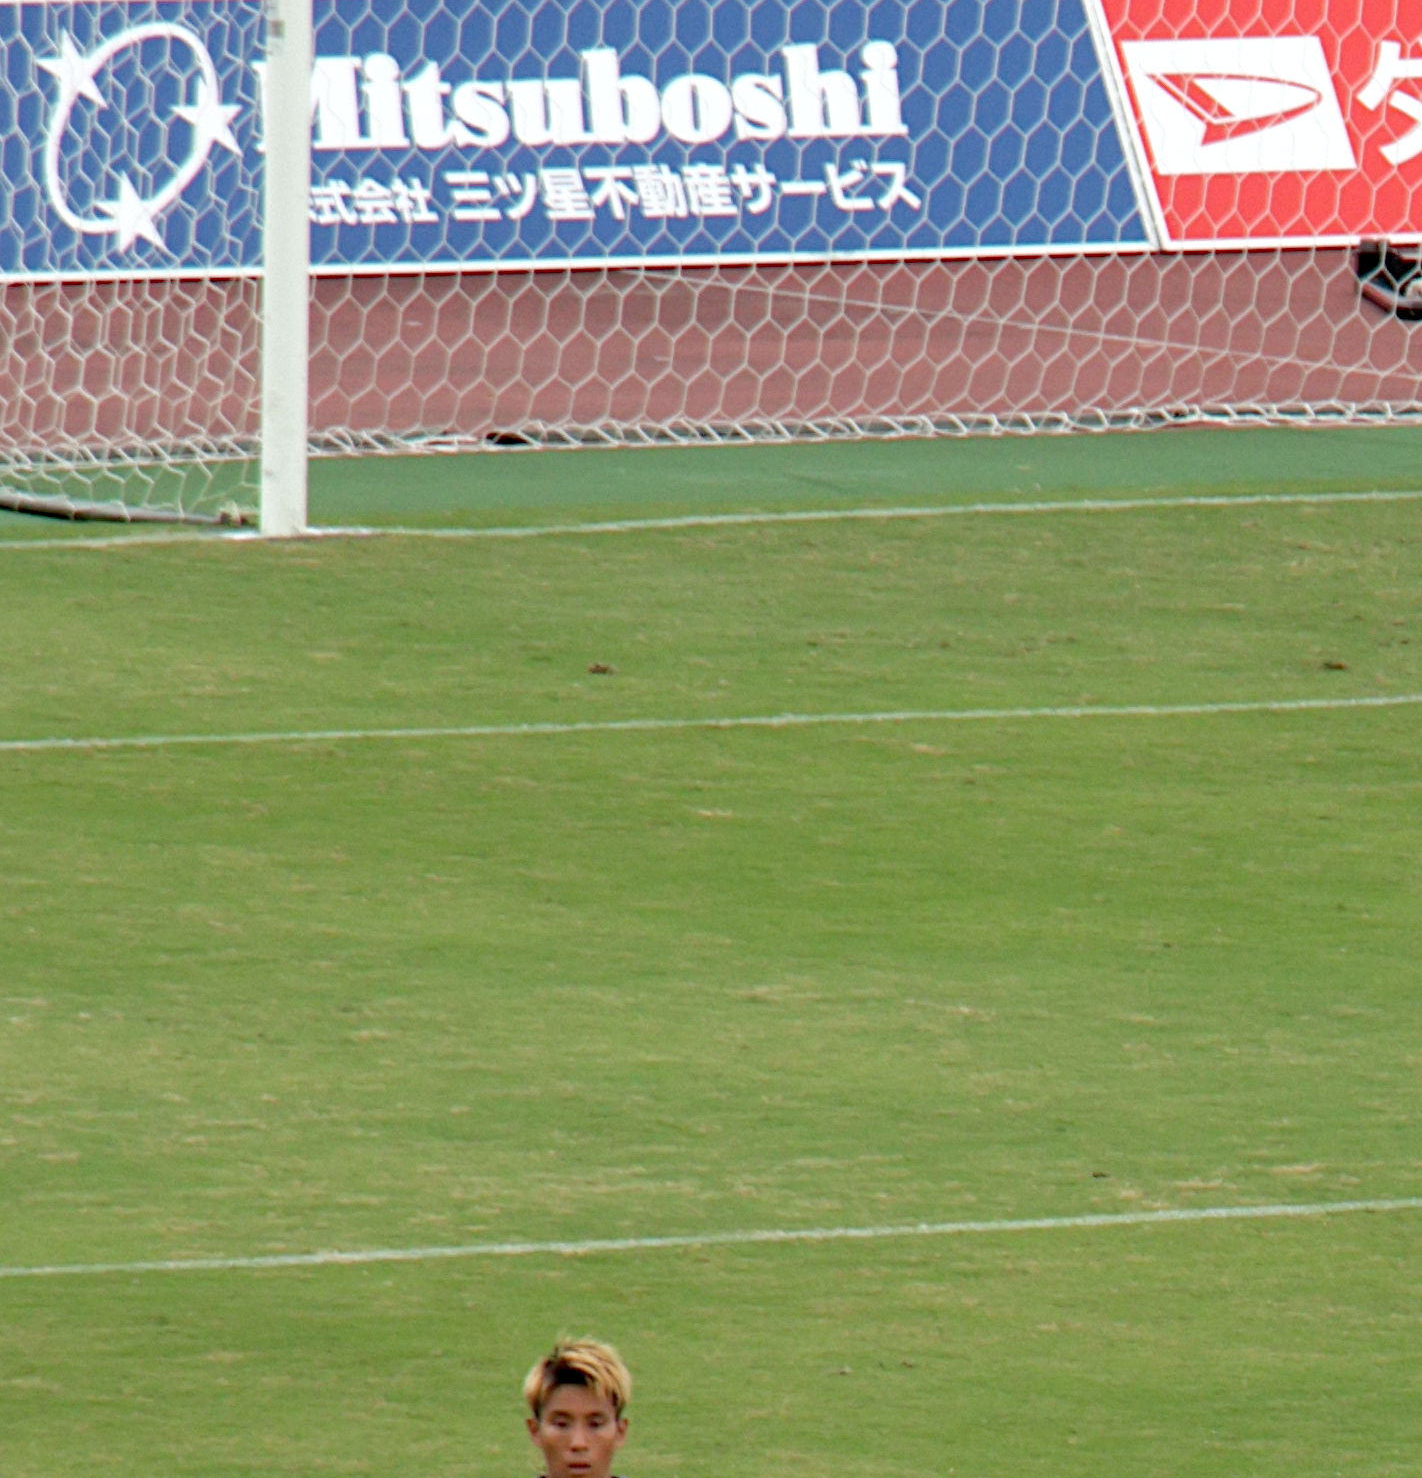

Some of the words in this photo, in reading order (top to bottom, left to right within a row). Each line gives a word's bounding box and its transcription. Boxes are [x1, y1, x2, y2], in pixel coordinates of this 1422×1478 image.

[252, 39, 909, 151] Mitsuboshi
[309, 177, 440, 226] 式会社
[445, 159, 922, 221] 三ツ星不動産サービス
